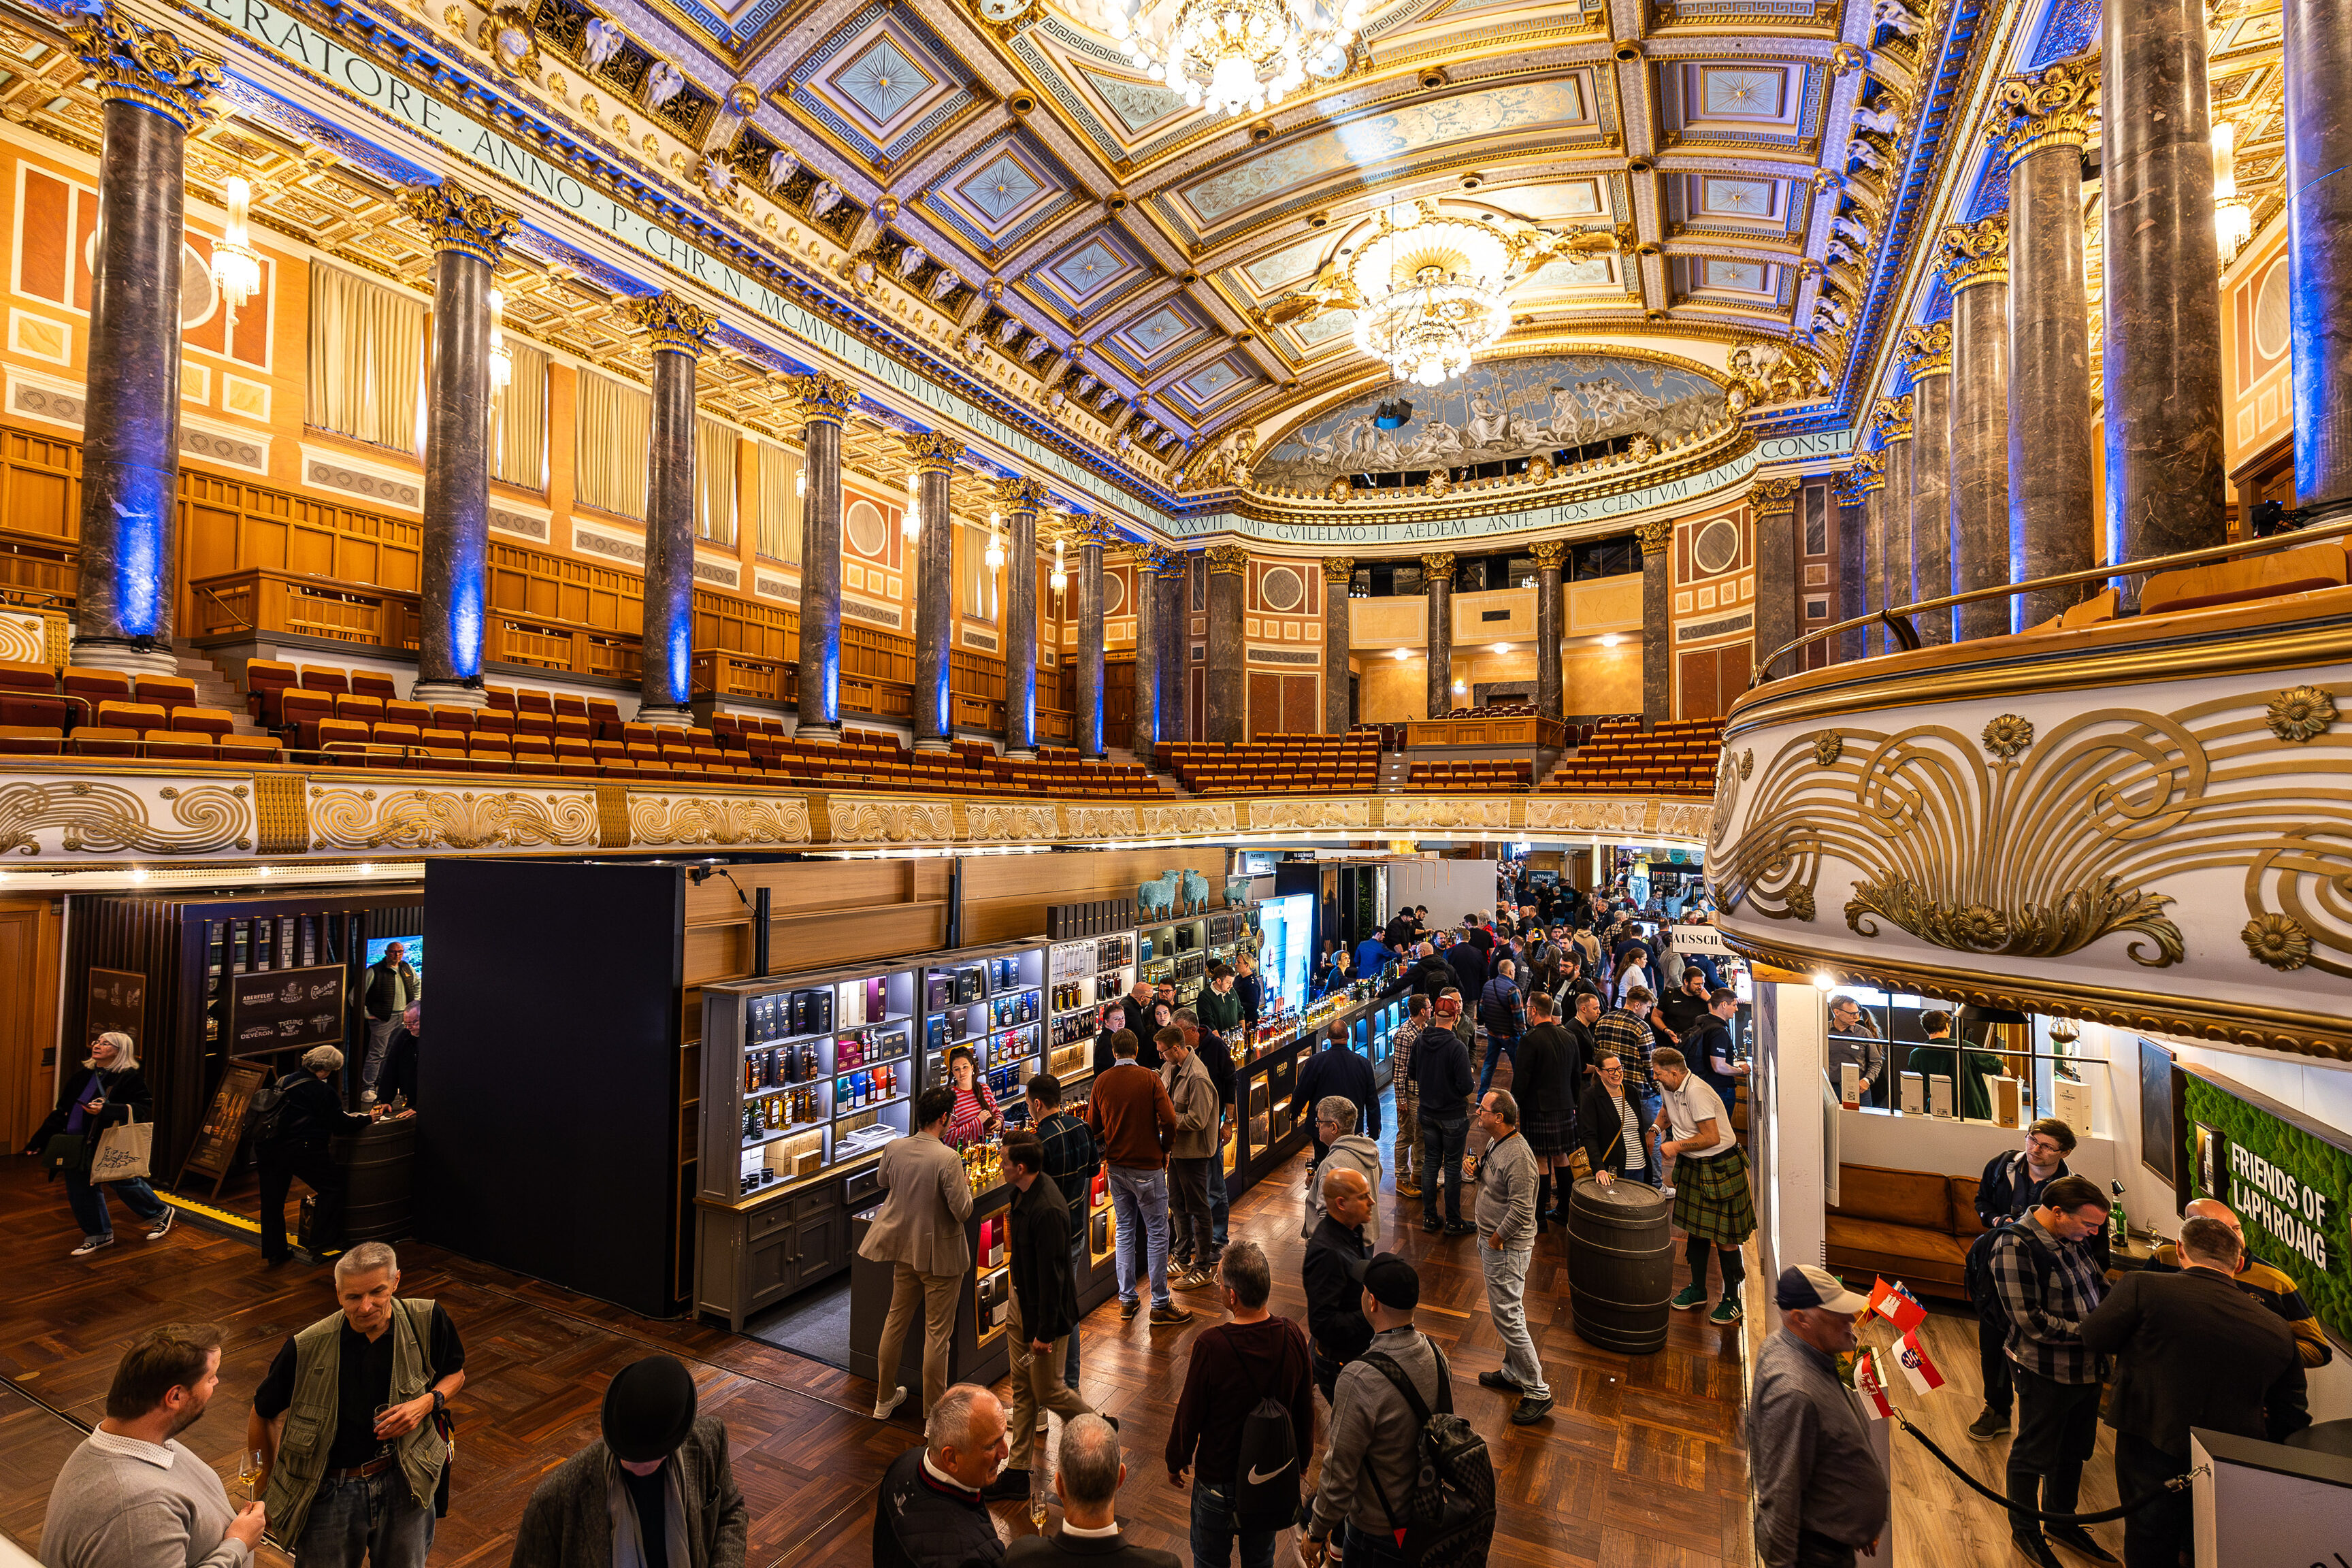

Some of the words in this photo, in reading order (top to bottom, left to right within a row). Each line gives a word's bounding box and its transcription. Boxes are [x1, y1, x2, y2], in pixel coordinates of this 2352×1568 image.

[471, 130, 584, 208] ANNO
[611, 206, 627, 231] P
[646, 226, 708, 280] CHR
[723, 267, 742, 298] N
[760, 289, 847, 357] MCMVII
[863, 348, 954, 414] FVNDITVS
[966, 404, 1043, 463] RESTITVTA
[1053, 455, 1087, 486] ANNO
[1092, 477, 1099, 493] P
[1103, 484, 1124, 509] CHR
[1128, 497, 1136, 514] N
[1240, 518, 1265, 536] IMP
[1276, 524, 1367, 541] GVILELMO
[1377, 526, 1388, 540] II
[1404, 520, 1468, 538] AEDEM
[1486, 510, 1535, 532] ANTE
[1550, 503, 1589, 523] HOS
[1602, 480, 1688, 514] CENTVM
[1703, 449, 1757, 491] ANNOS
[1761, 430, 1853, 459] CONSTI
[1673, 933, 1722, 945] AUSSCH
[242, 992, 274, 1001] ABERFELDY
[2232, 1141, 2298, 1210] FRIENDS
[2302, 1185, 2326, 1228] OF
[2233, 1179, 2328, 1271] LAPHROAIG
